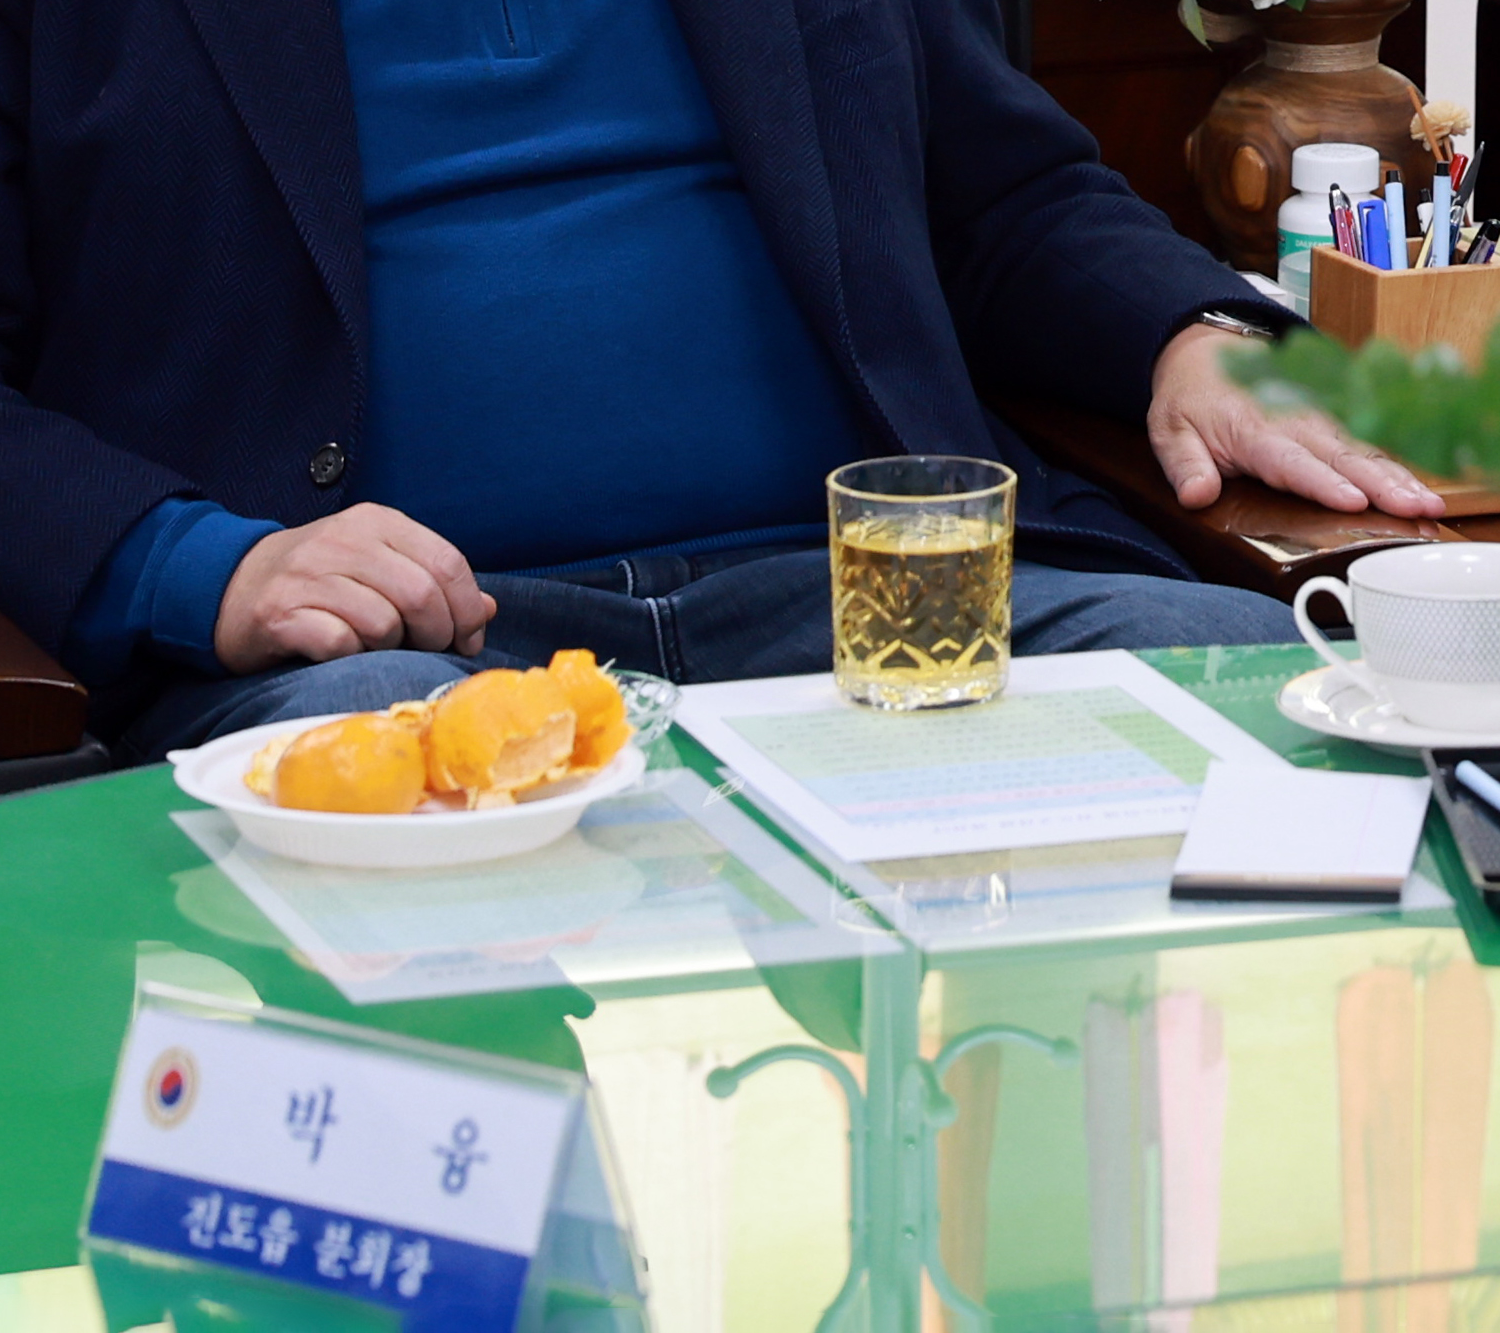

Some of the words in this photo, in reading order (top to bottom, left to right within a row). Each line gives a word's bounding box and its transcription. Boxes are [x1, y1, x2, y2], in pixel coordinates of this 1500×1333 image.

[286, 1083, 339, 1167] 박
[182, 1191, 299, 1267] 진도읍
[313, 1220, 434, 1300] 분회장
